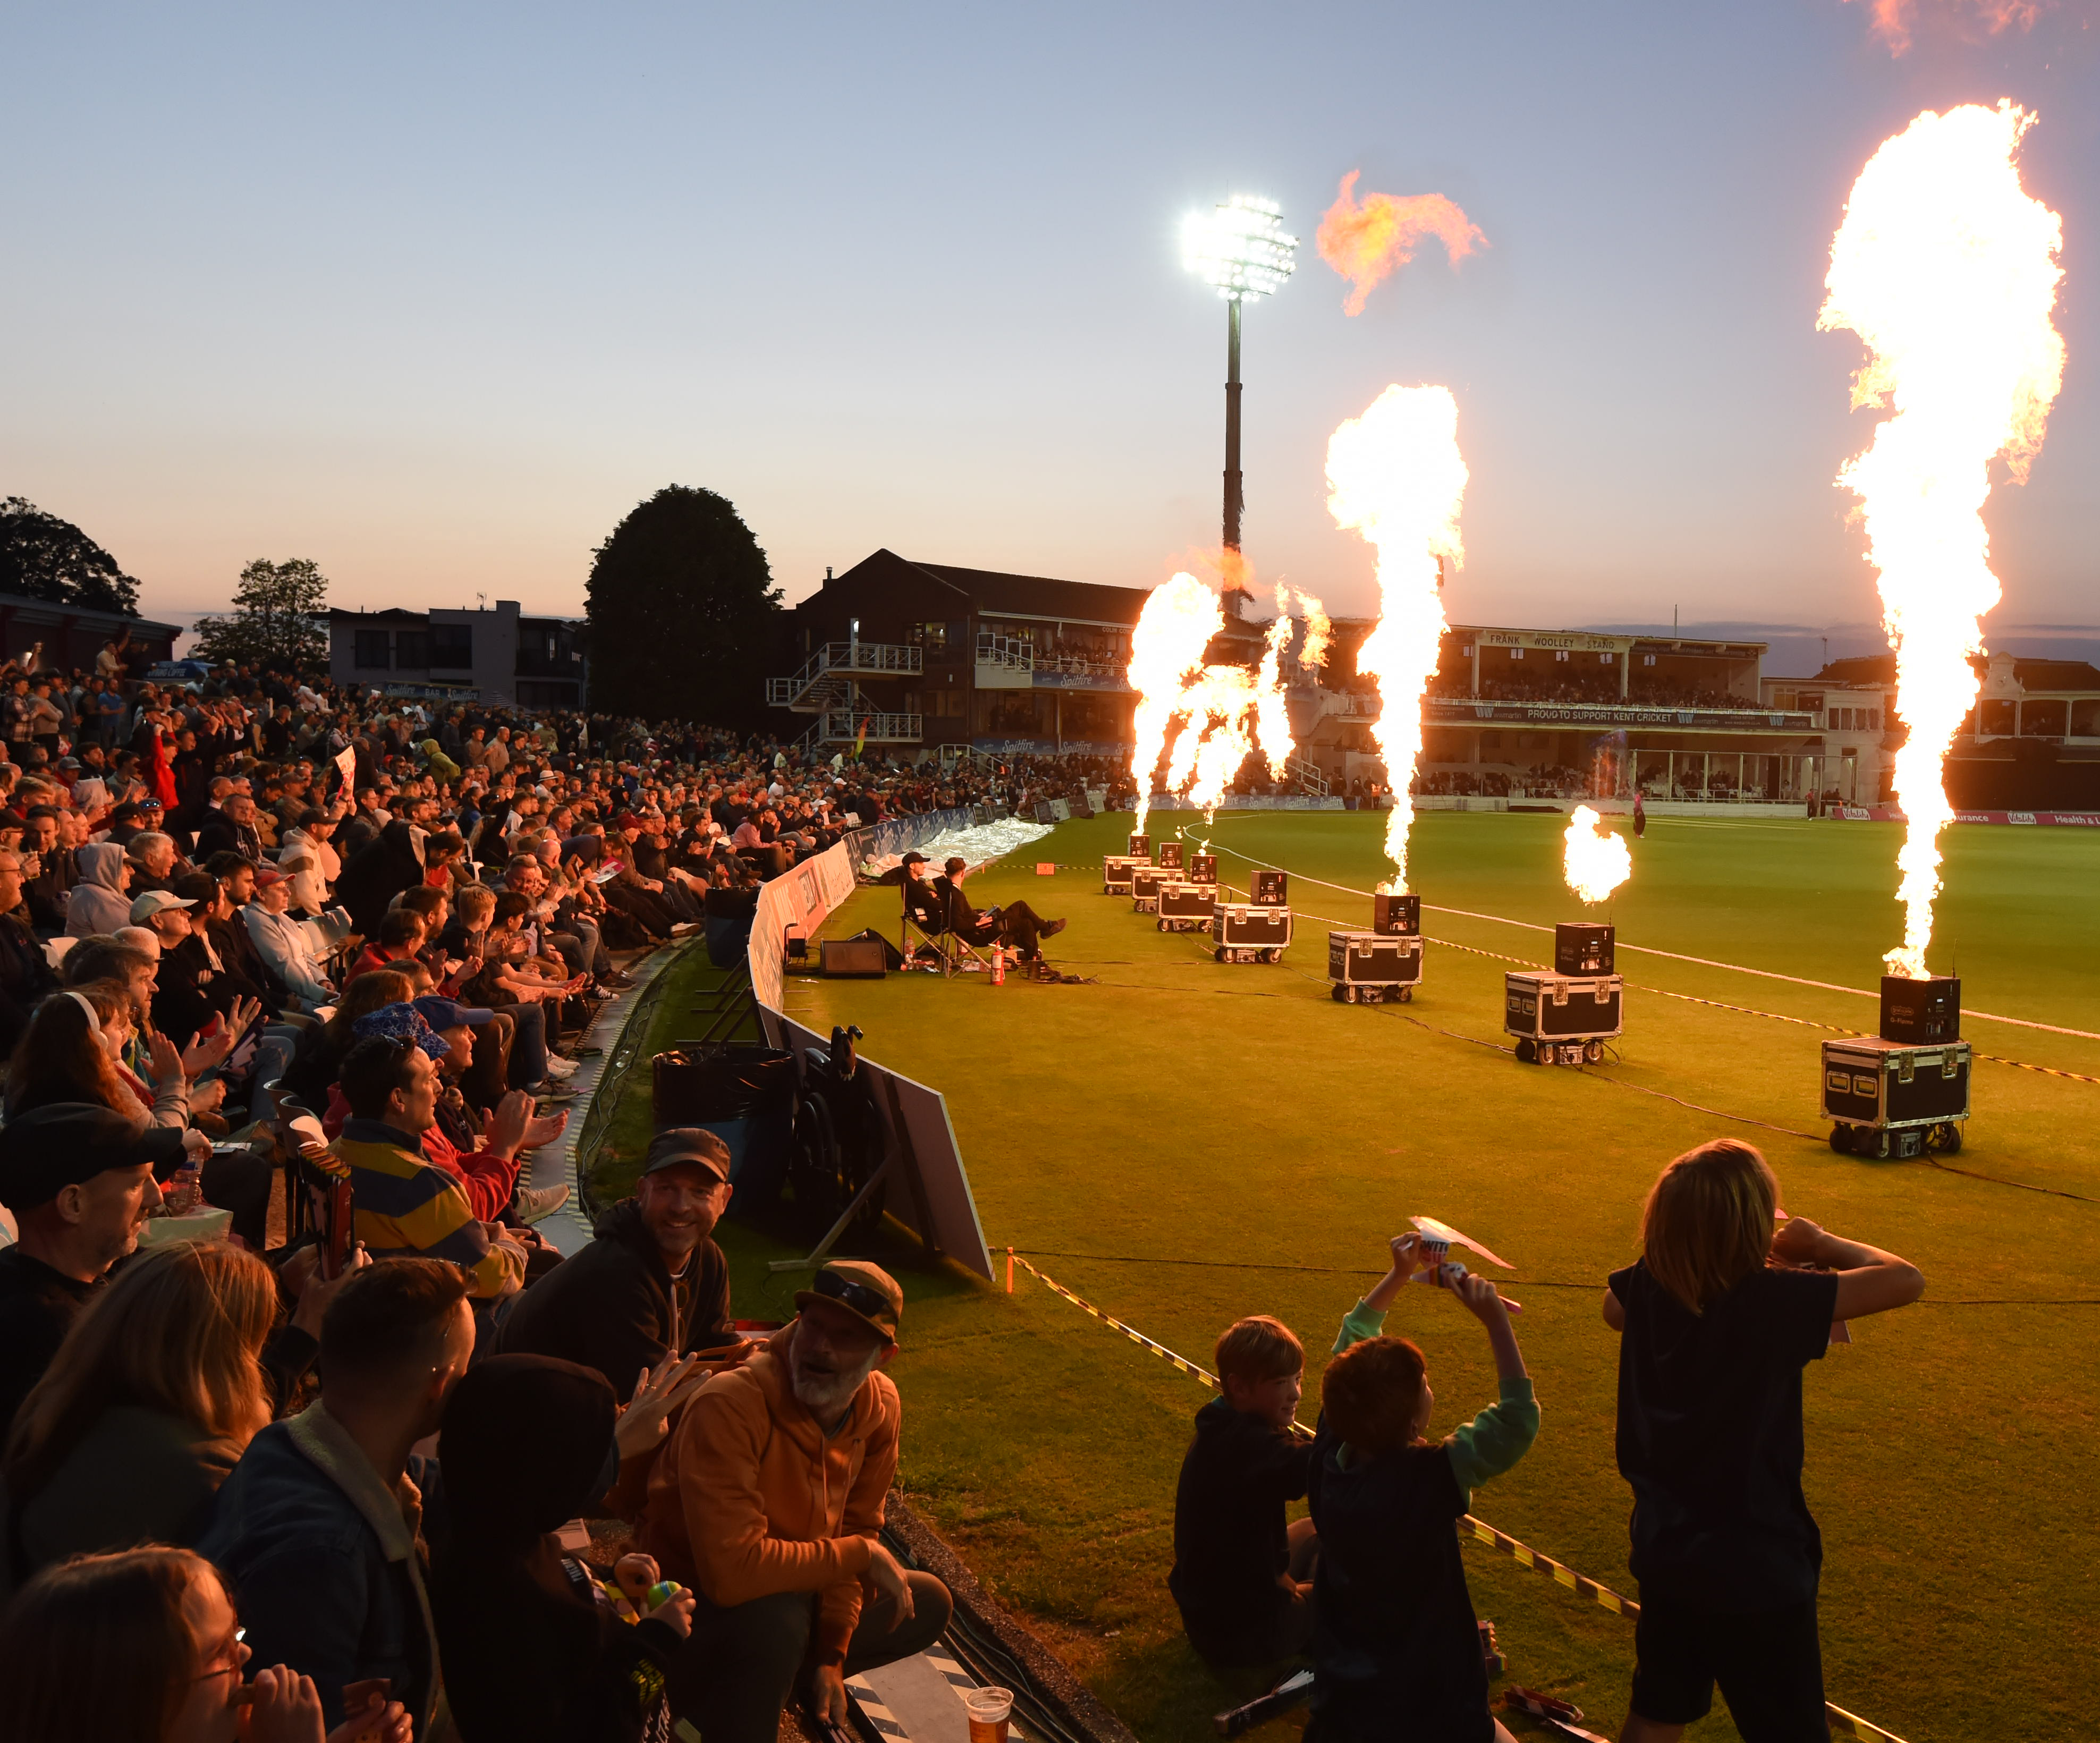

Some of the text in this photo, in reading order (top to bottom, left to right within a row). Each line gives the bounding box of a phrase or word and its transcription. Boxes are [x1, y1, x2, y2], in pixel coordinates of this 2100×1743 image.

[1491, 634, 1614, 649] FRANK WOOLLEY STAND
[1061, 674, 1093, 689] Spitfire
[386, 684, 416, 696] Spitfire
[426, 688, 440, 697] BAR
[1528, 709, 1672, 722] PROUD TO SUPPORT KENT CRICKET
[1002, 739, 1035, 754] Spitfire
[1061, 740, 1093, 755] Spitfire
[1285, 796, 1310, 809] Spitfire
[1319, 796, 1343, 809] Spitfire
[2055, 815, 2086, 824] Health
